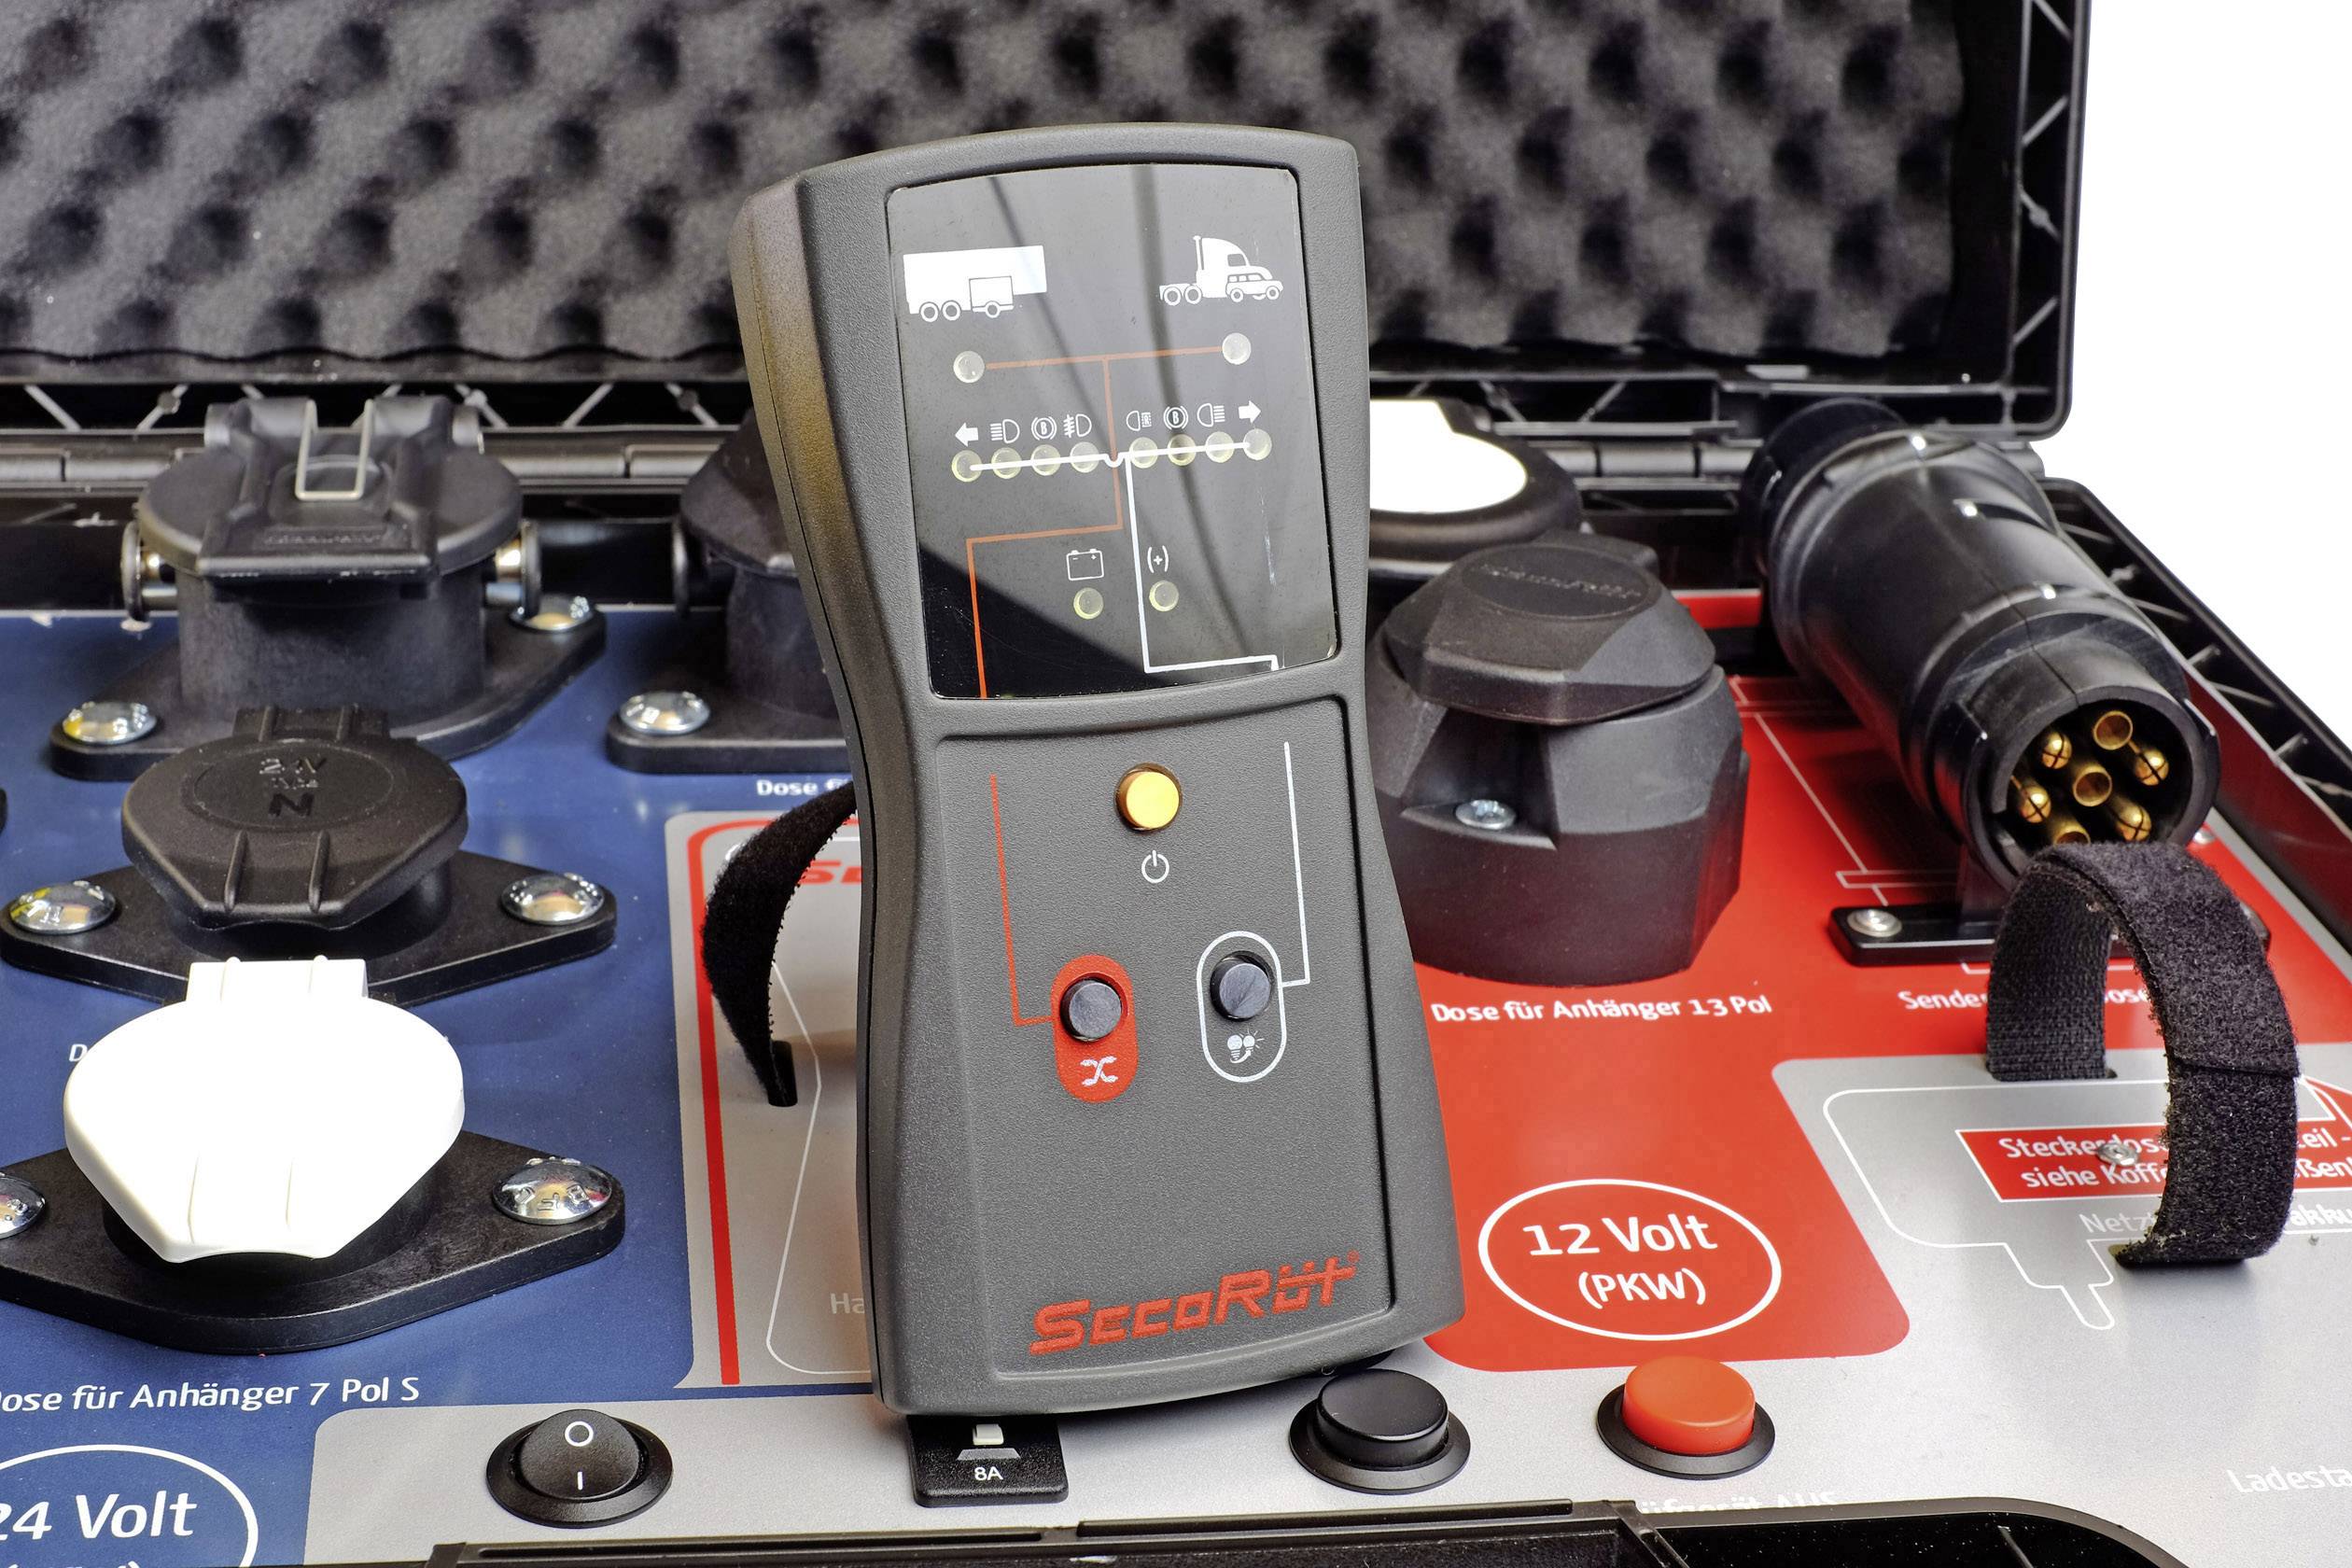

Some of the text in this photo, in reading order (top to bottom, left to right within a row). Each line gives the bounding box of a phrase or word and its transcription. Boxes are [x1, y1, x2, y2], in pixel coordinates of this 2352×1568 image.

[756, 779, 818, 796] Dose
[1430, 995, 1772, 1022] Dose für Anhänger 13 Pol
[2296, 1127, 2338, 1148] eil
[2021, 1166, 2099, 1187] siehe
[1522, 1213, 1718, 1255] 12 Volt
[1578, 1267, 1706, 1309] (PKW)
[0, 1377, 419, 1412] ose für Anhänger 7 Pol S
[974, 1466, 1003, 1480] 8A
[76, 1490, 198, 1539] Volt
